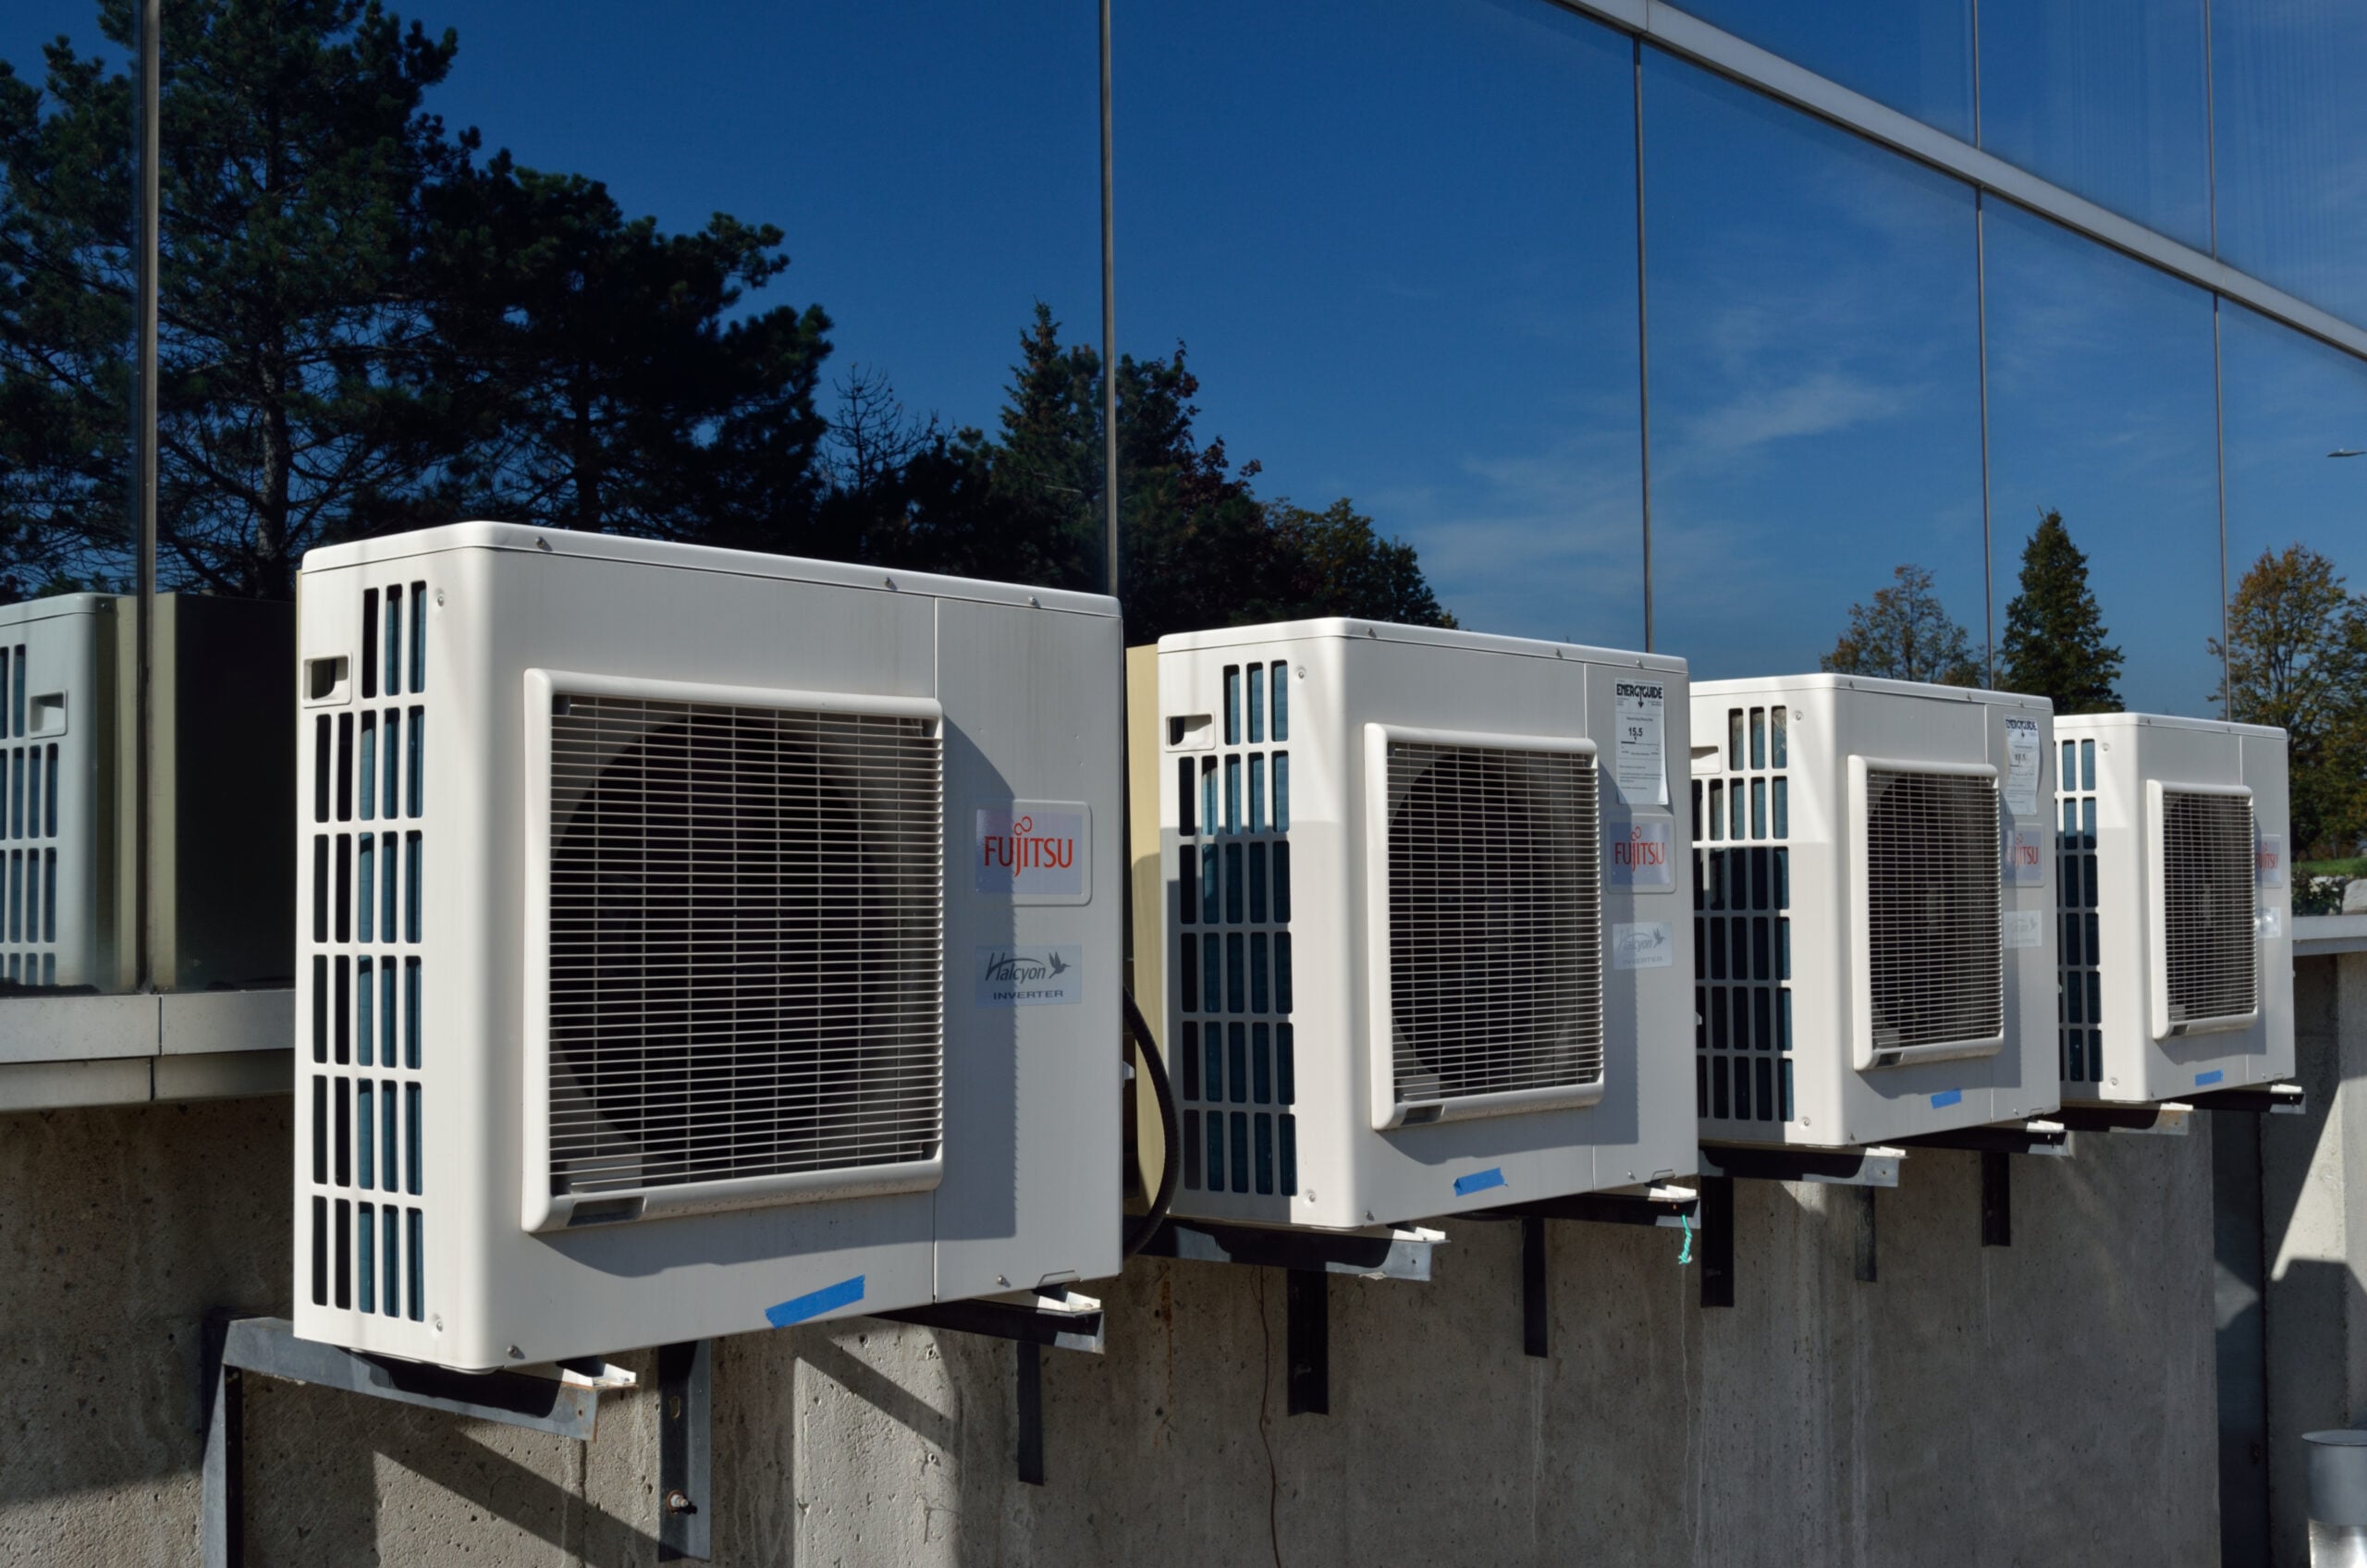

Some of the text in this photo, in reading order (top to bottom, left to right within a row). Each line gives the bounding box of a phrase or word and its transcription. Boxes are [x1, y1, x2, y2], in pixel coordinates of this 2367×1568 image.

[984, 835, 1073, 877] FUJITSU
[1614, 841, 1665, 873] FUJITSU
[2008, 845, 2039, 868] UJITSU
[985, 951, 1046, 984] Halcyon
[993, 990, 1064, 1000] INVERTER
